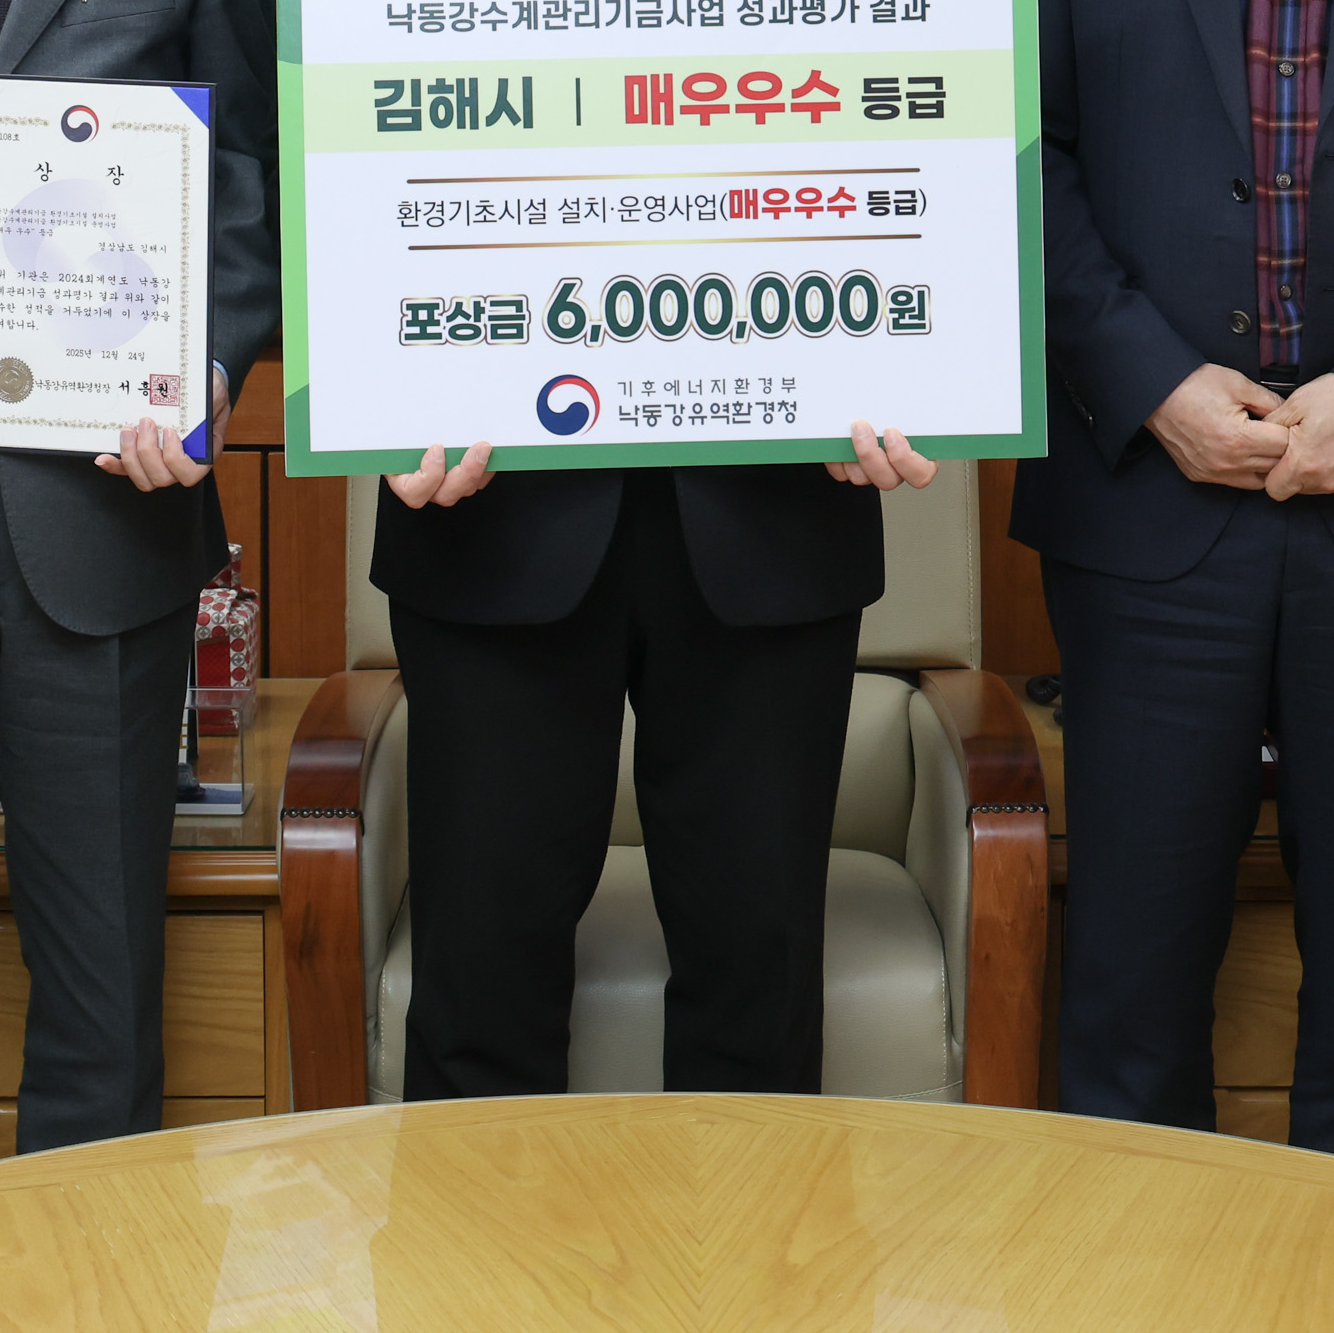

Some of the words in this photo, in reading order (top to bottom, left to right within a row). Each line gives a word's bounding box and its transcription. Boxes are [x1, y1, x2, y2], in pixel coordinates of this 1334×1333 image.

[373, 76, 535, 132] 김해시
[624, 69, 842, 128] 매우우수
[861, 76, 947, 120] 등급
[395, 197, 548, 228] 환경기초시설
[98, 242, 135, 252] 경상남도
[141, 243, 167, 254] 김해시
[17, 270, 49, 281] 기관은
[58, 273, 129, 286] 2024회계연도
[139, 277, 171, 289] 낙동강
[53, 288, 93, 300] 성과평가
[99, 291, 118, 302] 결과
[125, 292, 144, 304] 위와
[122, 309, 131, 319] 이
[402, 298, 528, 343] 포상금
[547, 274, 928, 344] 6,000,000원
[65, 349, 92, 359] 2025년
[101, 350, 118, 360] 12월
[128, 352, 145, 361] 24일
[618, 377, 798, 397] 기후에너지환경부
[618, 400, 798, 428] 낙동강유역환경청
